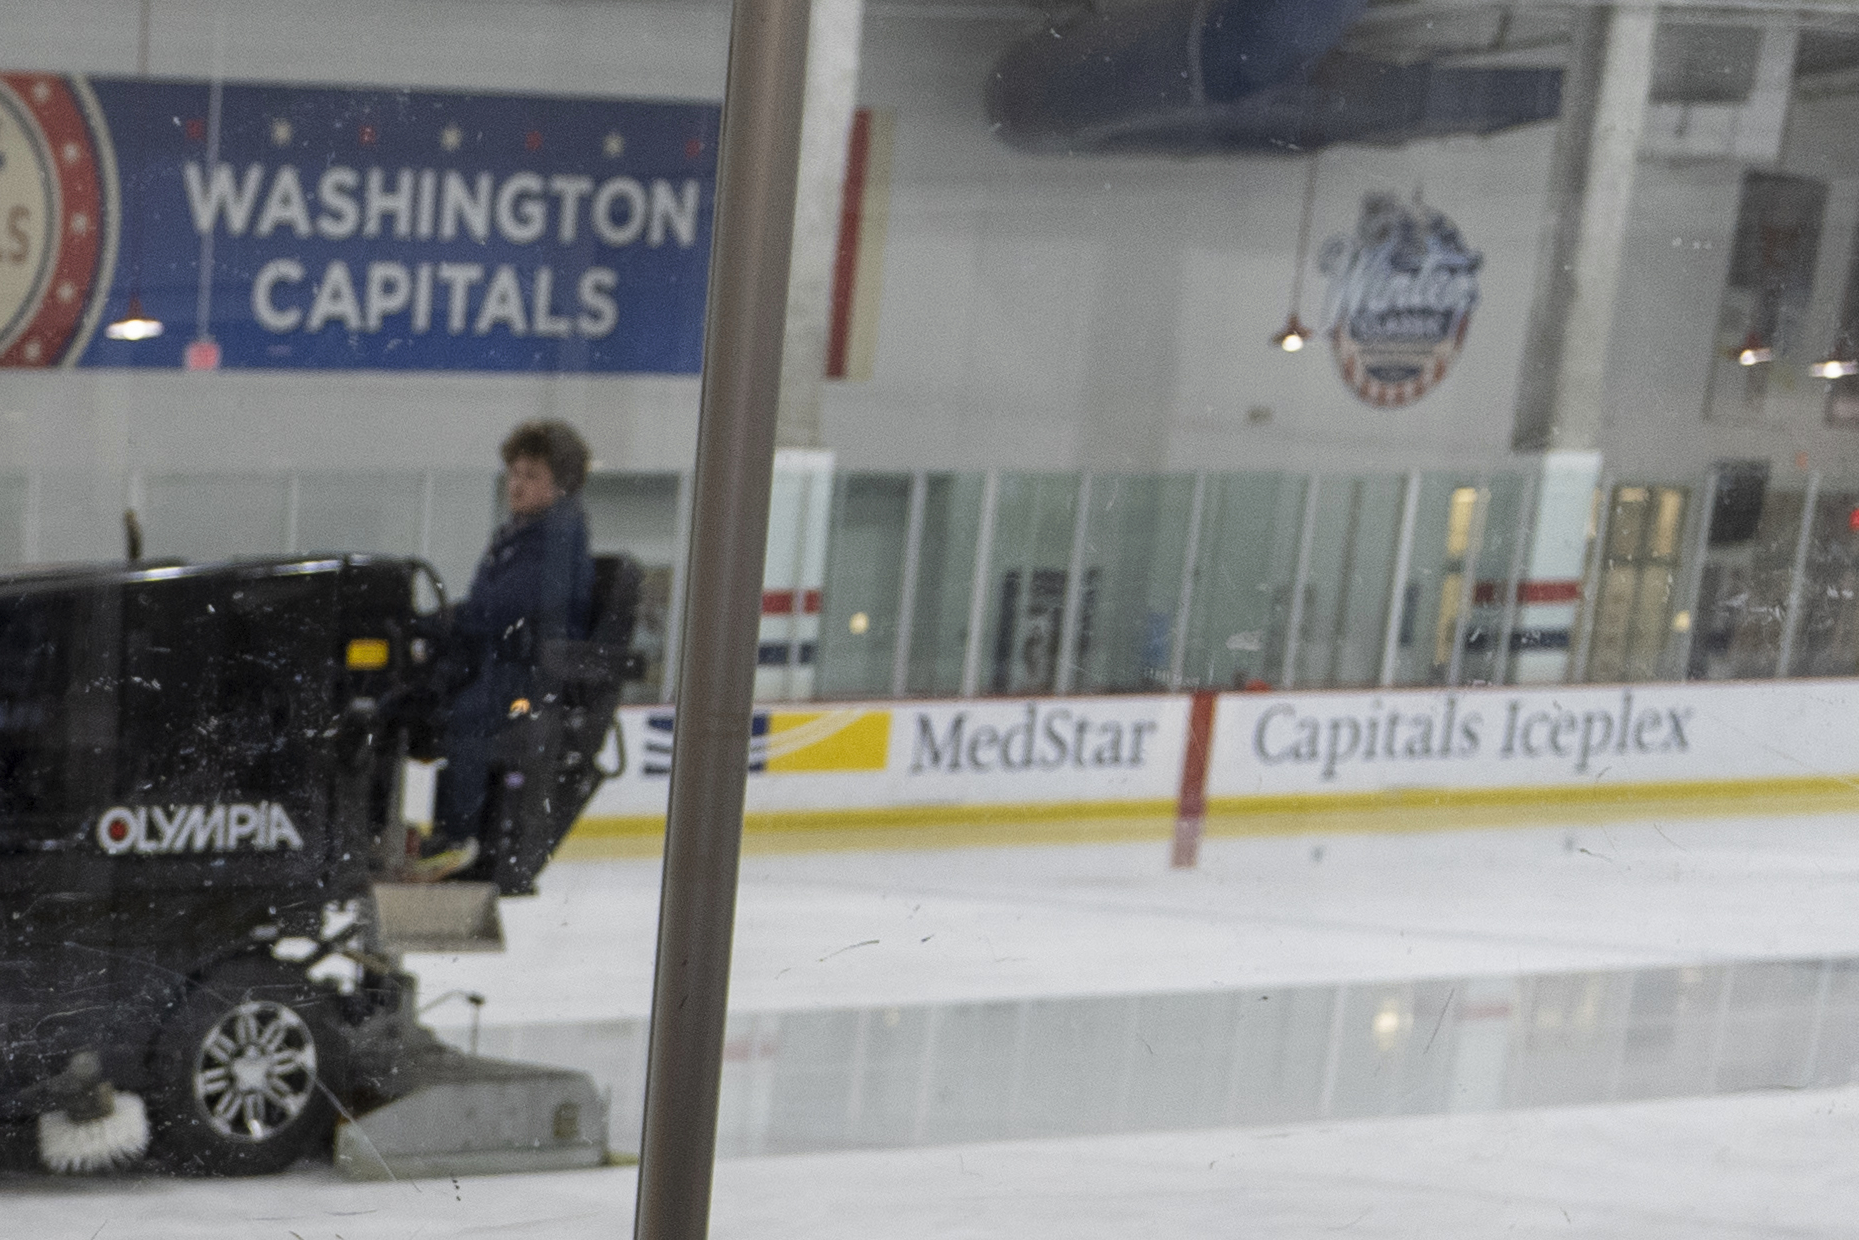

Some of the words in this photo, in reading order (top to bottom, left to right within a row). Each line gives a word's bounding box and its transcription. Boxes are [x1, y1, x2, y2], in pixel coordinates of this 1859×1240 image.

[183, 160, 701, 250] WASHINGTON
[251, 257, 620, 340] CAPITALS
[909, 703, 1159, 776] MedStar
[1250, 692, 1483, 783] Capitals
[1498, 687, 1696, 775] Iceplex
[95, 801, 304, 854] OLYMPIA
